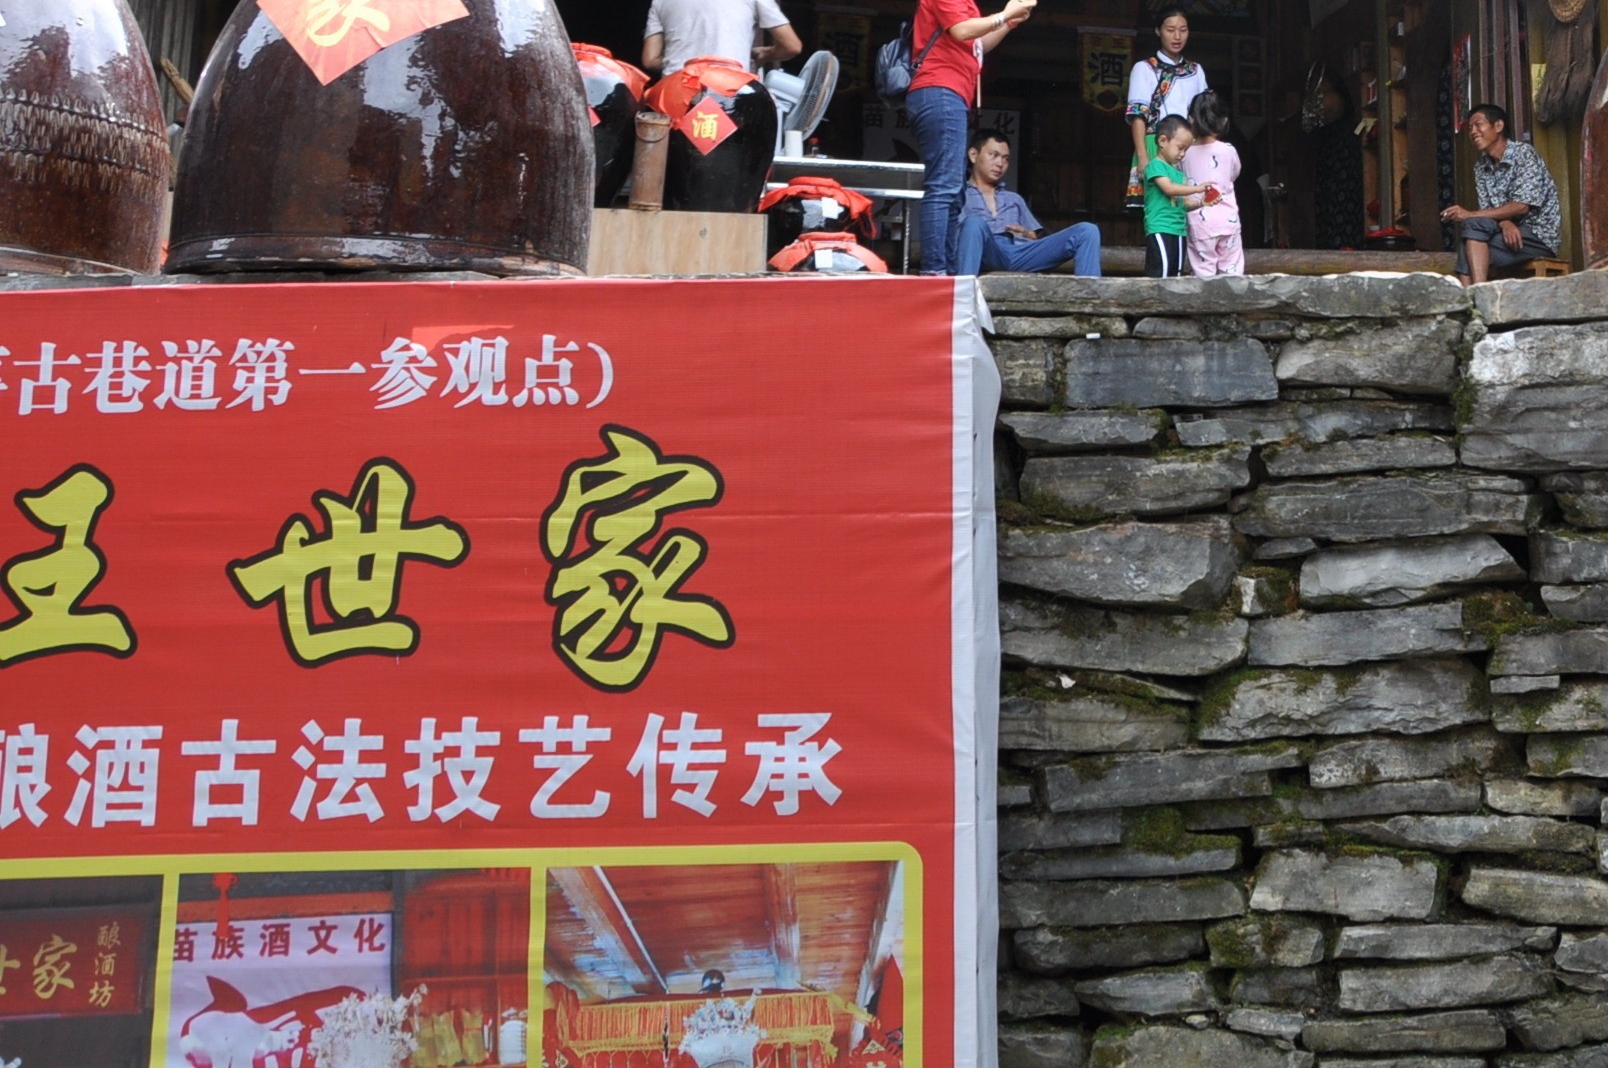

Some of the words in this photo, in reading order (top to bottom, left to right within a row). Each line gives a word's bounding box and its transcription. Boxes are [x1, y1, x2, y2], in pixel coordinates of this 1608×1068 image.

[1087, 52, 1127, 87] 酒
[692, 111, 719, 140] 酒
[0, 335, 615, 416] 古巷道第一参观点)
[0, 423, 736, 692] 王世家
[89, 921, 122, 1008] 酿酒坊
[172, 918, 387, 963] 苗族酒文化
